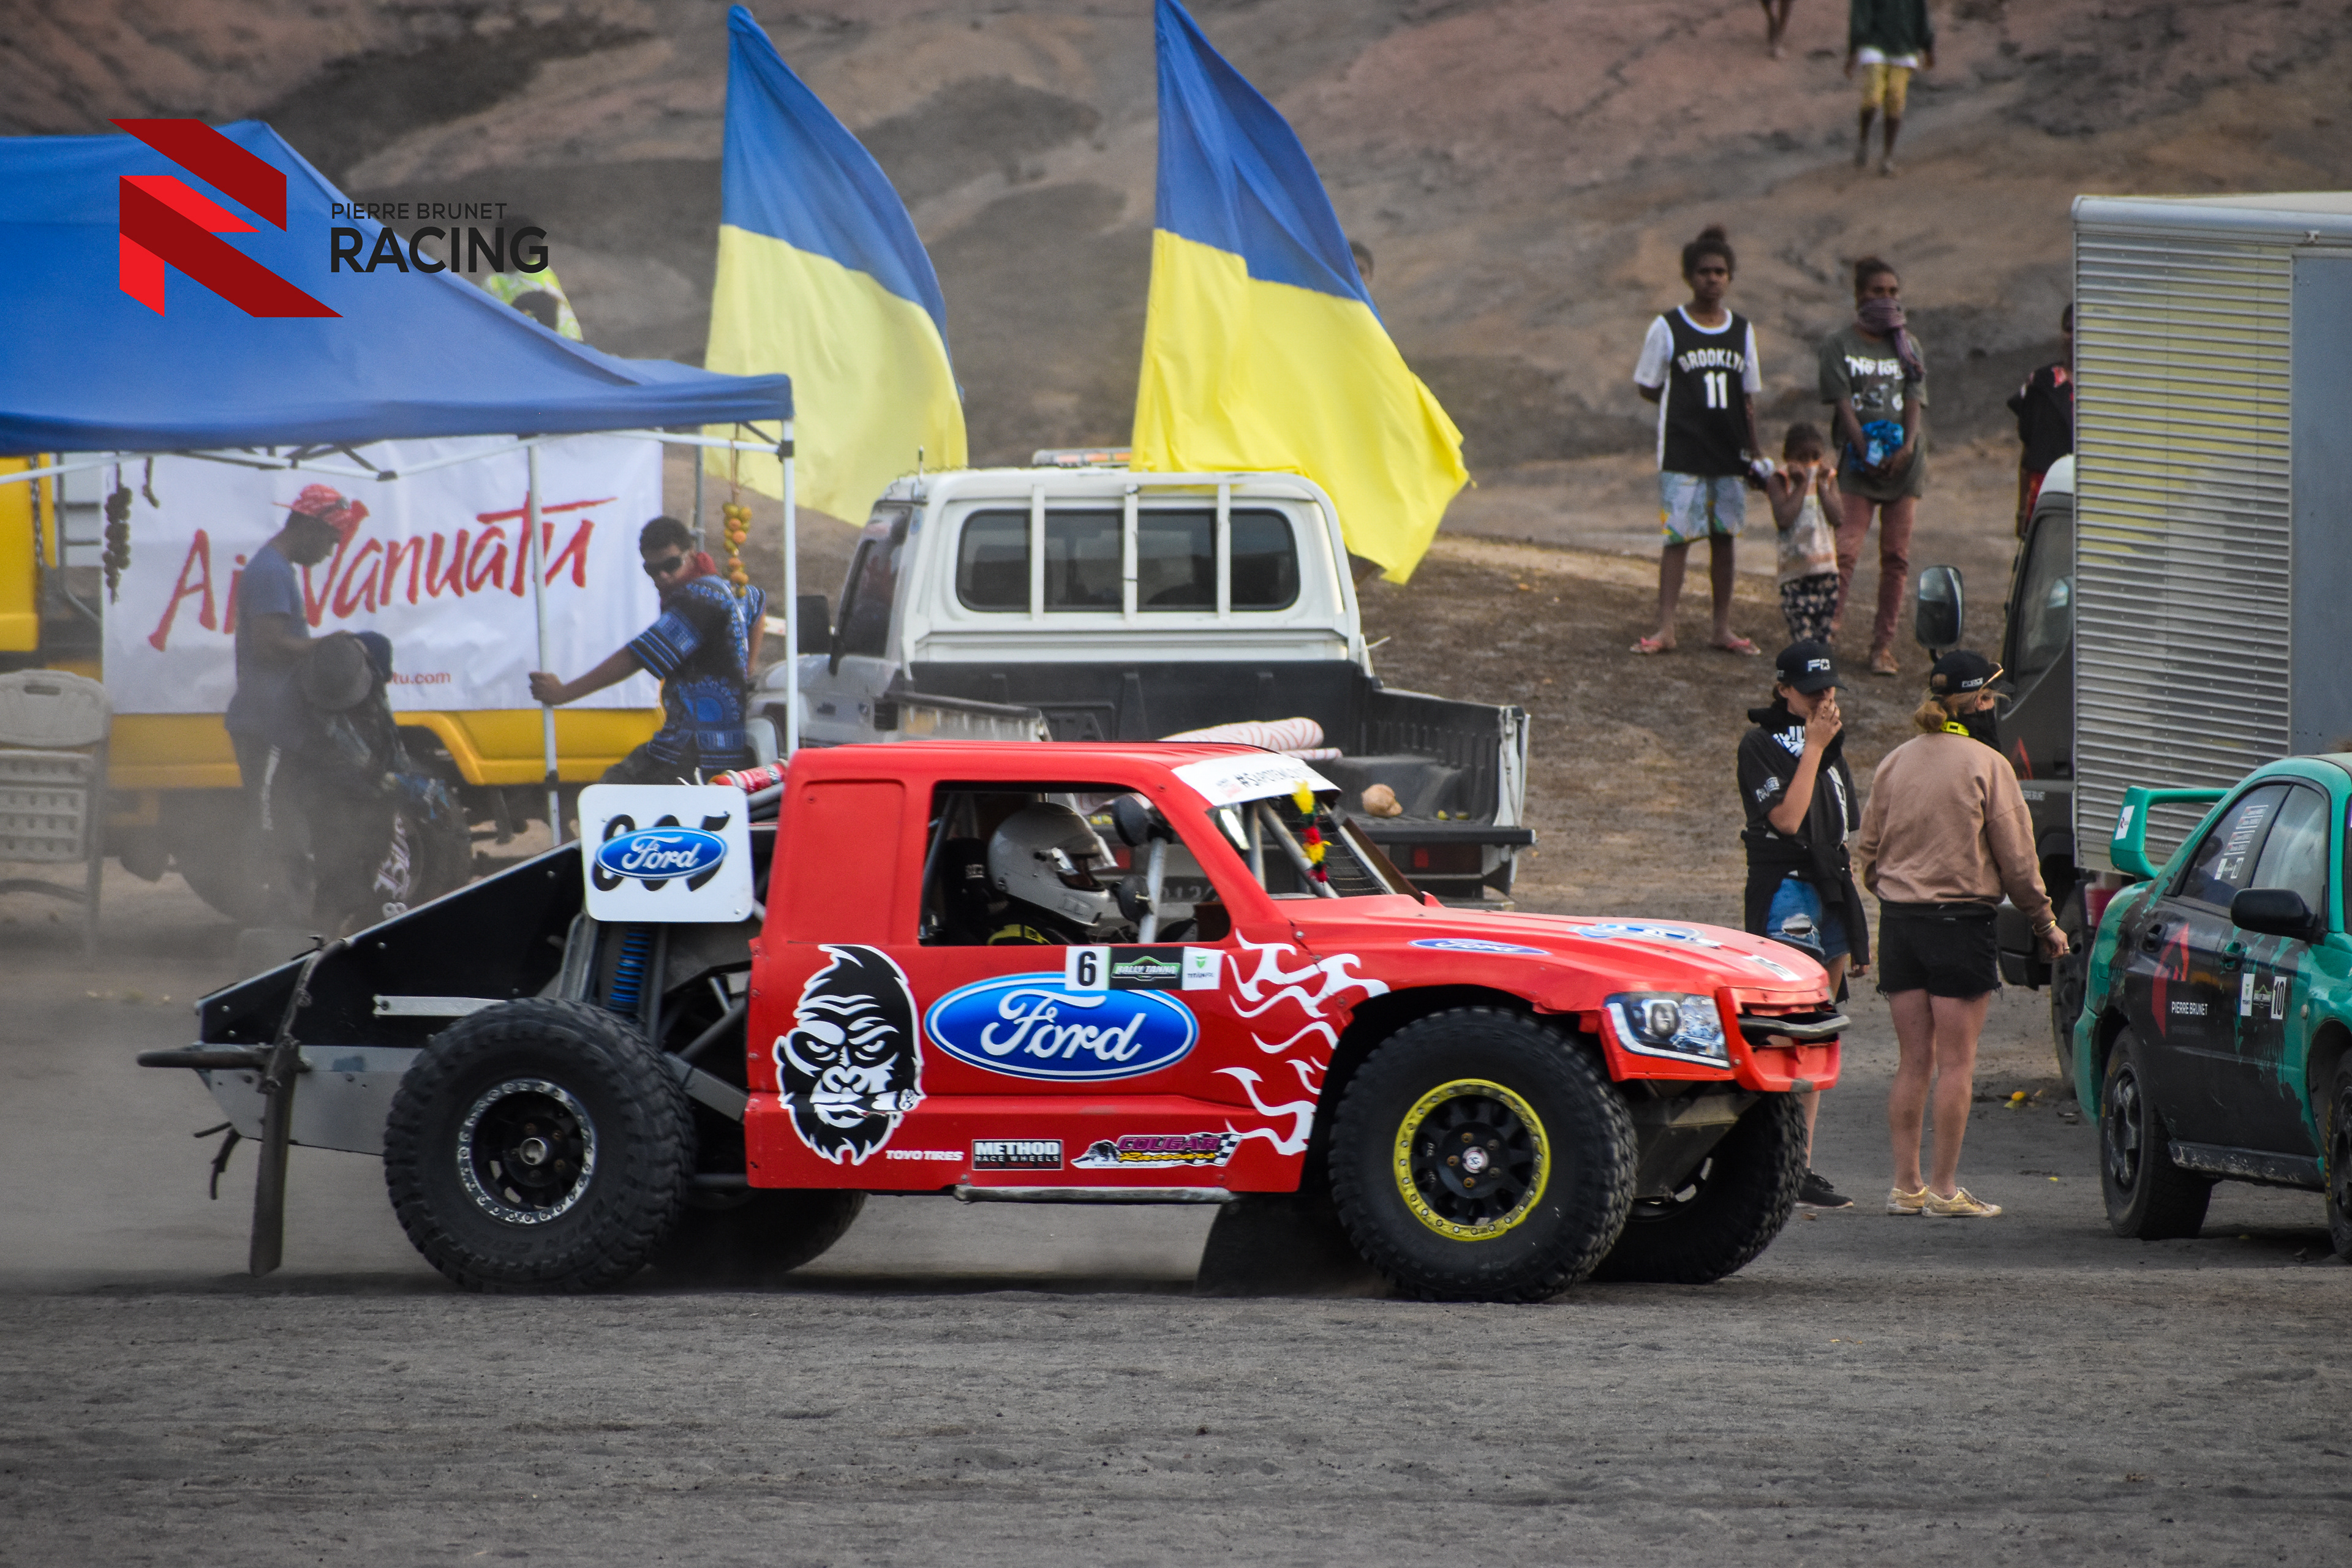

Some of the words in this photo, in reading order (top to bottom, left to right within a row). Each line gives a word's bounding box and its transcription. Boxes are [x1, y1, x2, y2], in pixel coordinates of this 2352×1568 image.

[1703, 370, 1728, 409] 11
[148, 528, 246, 651] Ai
[621, 835, 703, 870] Ford
[1078, 951, 1097, 987] 6
[2171, 1001, 2189, 1016] PIERRE
[2190, 1001, 2208, 1016] BRUNET
[2273, 981, 2285, 1016] 10
[980, 989, 1148, 1061] Ford
[886, 1150, 923, 1160] TOYO
[923, 1151, 965, 1161] TIRES
[974, 1142, 1060, 1156] METHOD
[1117, 1137, 1222, 1151] COUGAR
